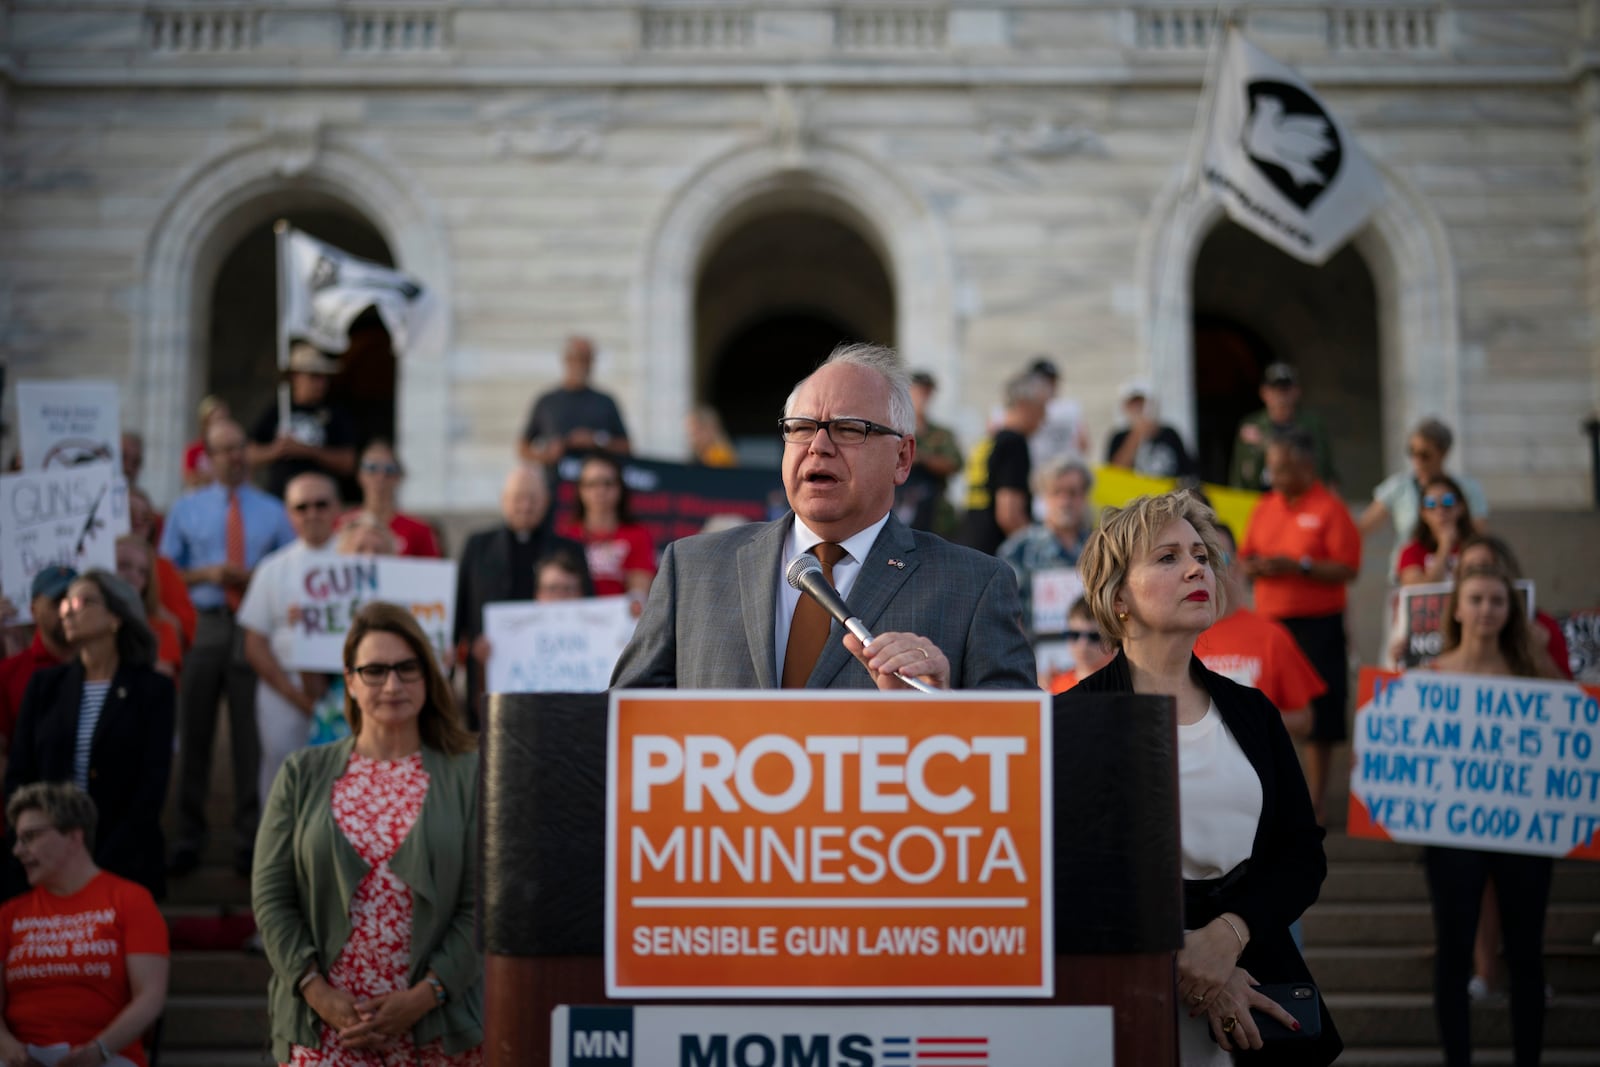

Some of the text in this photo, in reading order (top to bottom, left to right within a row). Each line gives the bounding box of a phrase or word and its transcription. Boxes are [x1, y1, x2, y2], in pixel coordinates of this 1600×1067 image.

[303, 560, 378, 599] GUN
[1374, 677, 1600, 724] IF YOU HAVE TO
[1366, 715, 1592, 760] USE AN AR-15 TO
[631, 734, 1027, 814] PROTECT
[1363, 752, 1600, 804] HUNT, YOU'RE NOT
[1366, 794, 1437, 831] VERY
[1447, 802, 1521, 838] GOOD
[1526, 812, 1565, 844] AT
[631, 825, 1027, 884] MINNESOTA
[632, 926, 1027, 956] SENSIBLE GUN LAWS NOW!
[574, 1031, 628, 1058] MN
[680, 1033, 874, 1067] MOMS
